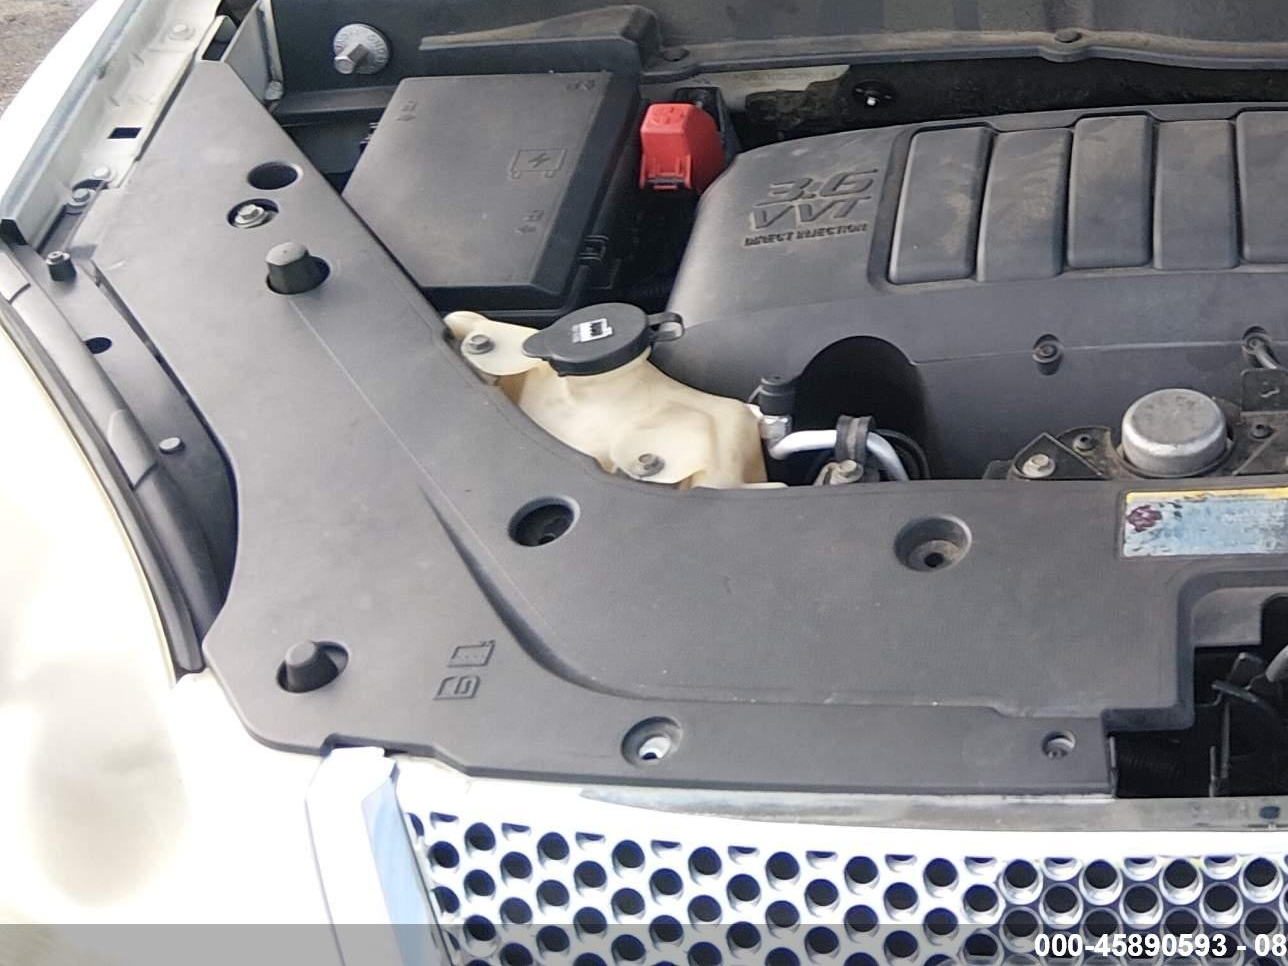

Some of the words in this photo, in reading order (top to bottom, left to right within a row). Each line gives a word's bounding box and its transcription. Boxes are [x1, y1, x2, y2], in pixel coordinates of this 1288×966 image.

[754, 168, 879, 207] 3.6
[749, 196, 872, 230] VVT
[743, 231, 794, 247] DIRECT
[796, 223, 869, 240] INJECTION
